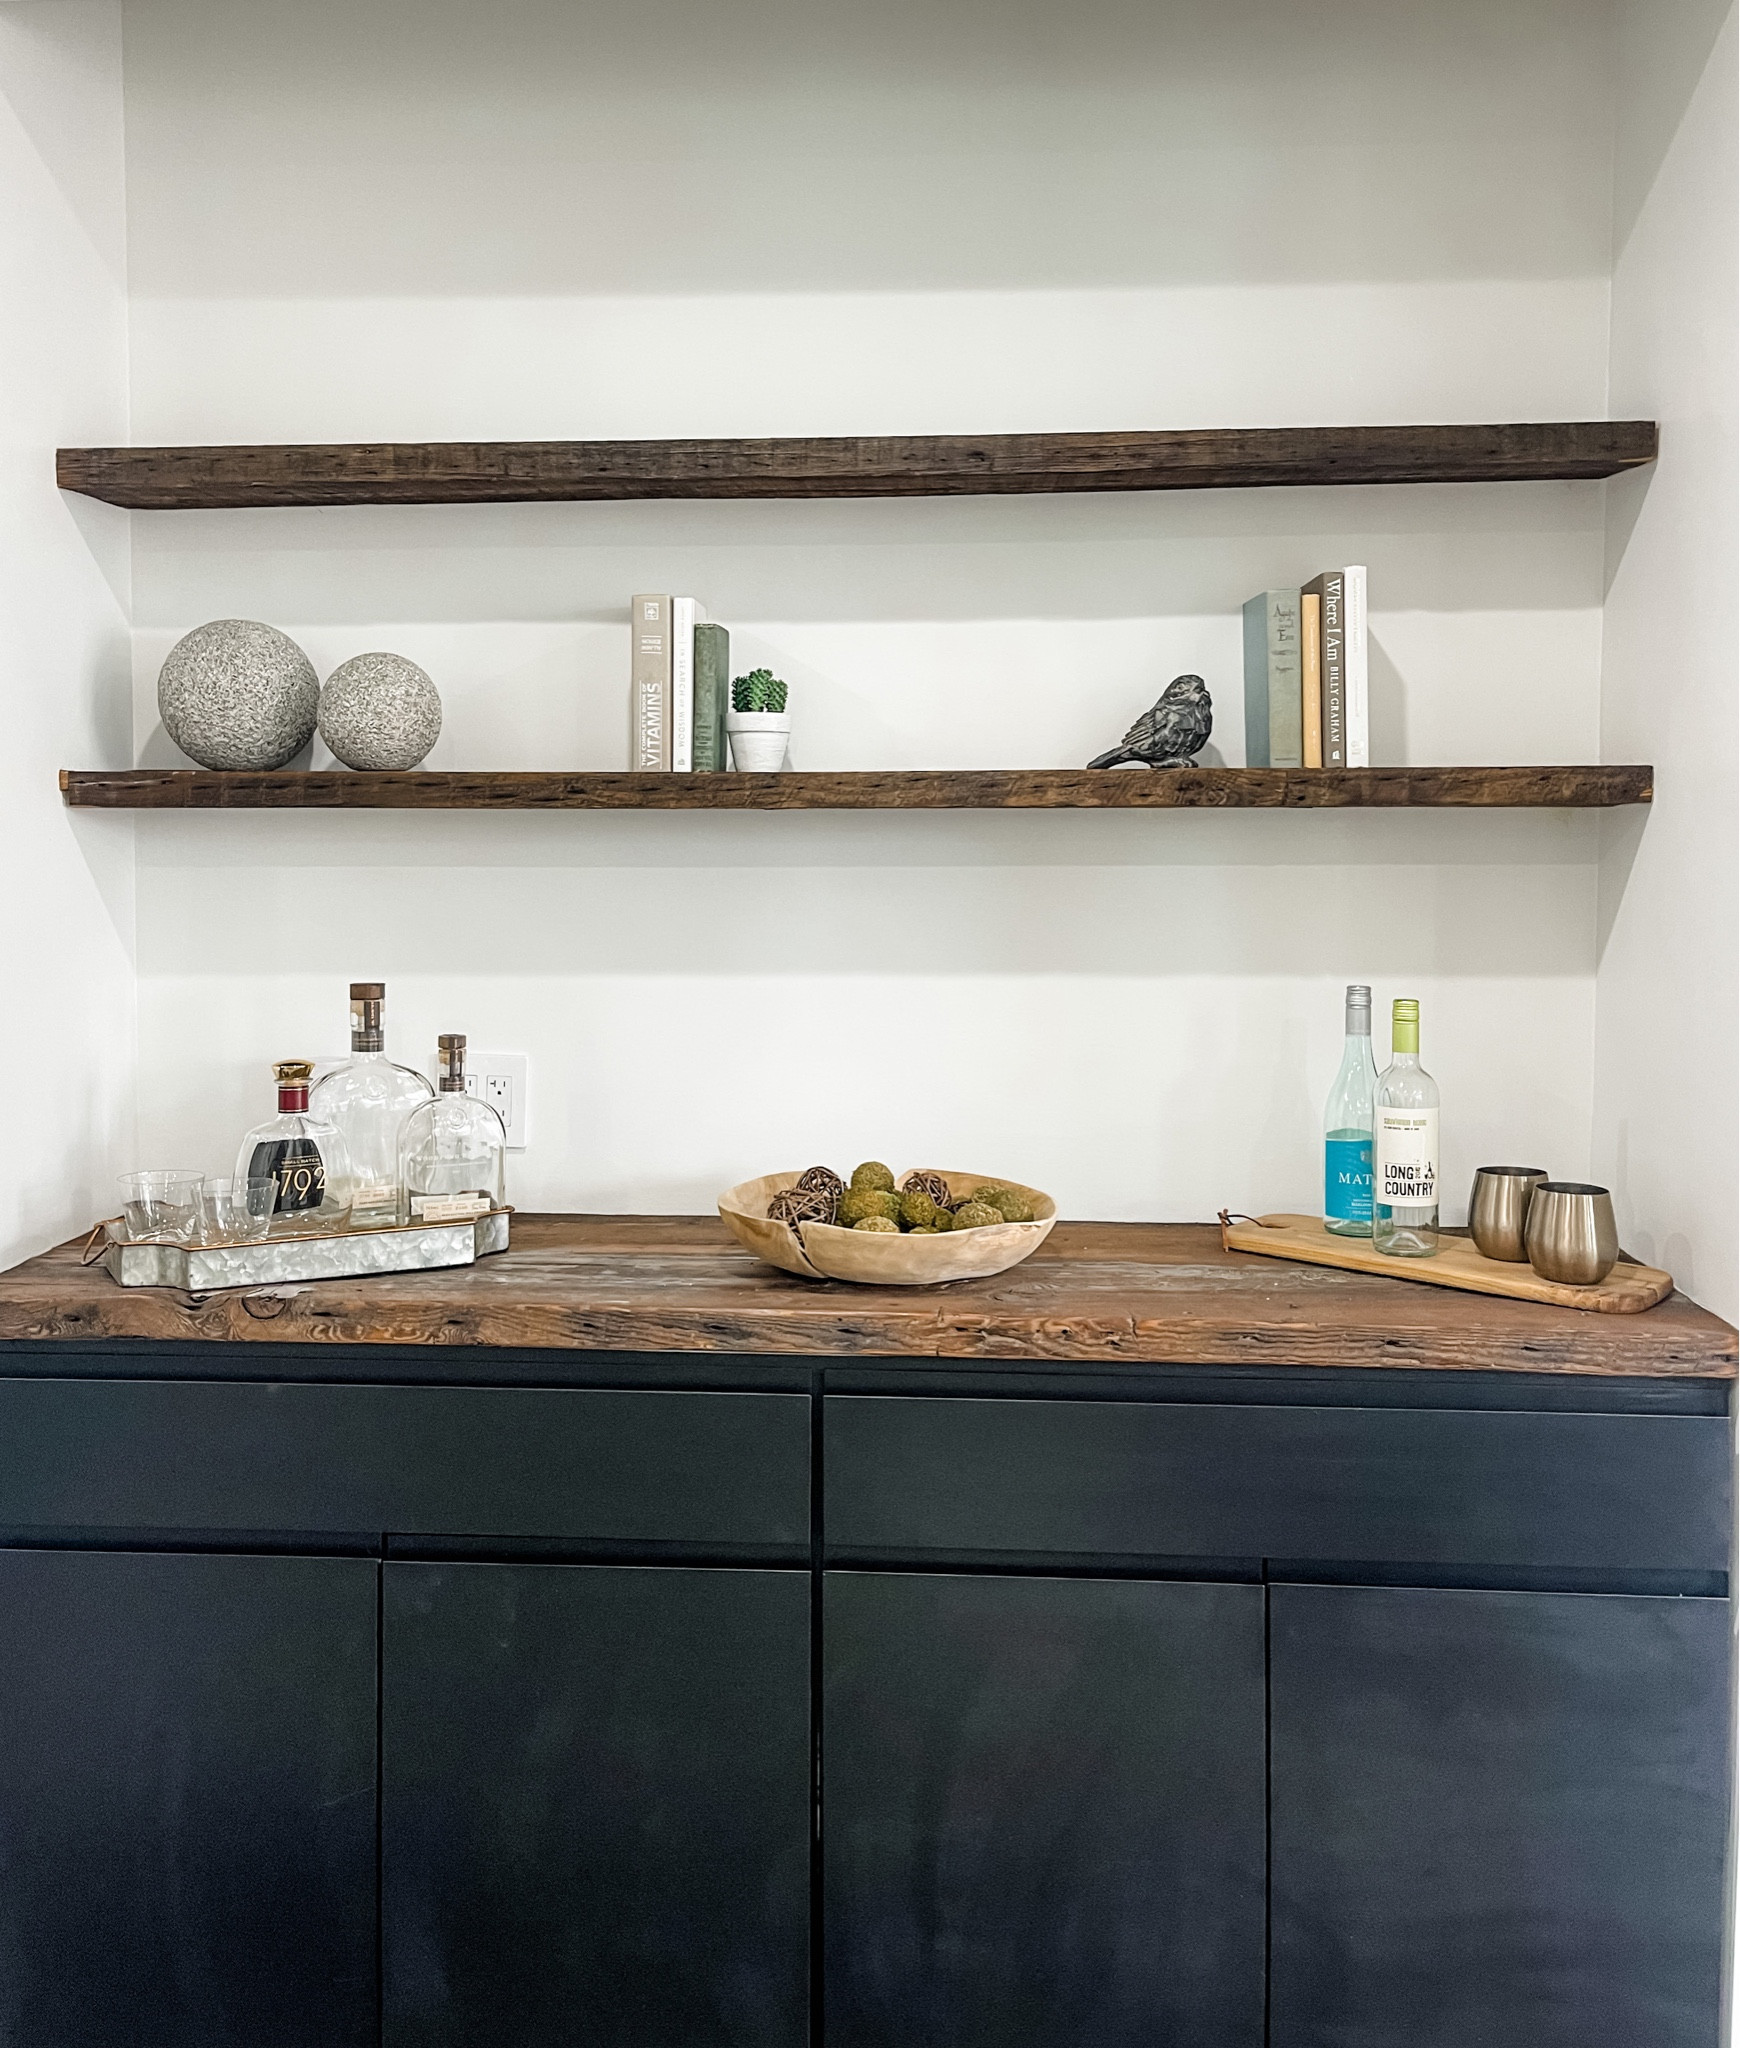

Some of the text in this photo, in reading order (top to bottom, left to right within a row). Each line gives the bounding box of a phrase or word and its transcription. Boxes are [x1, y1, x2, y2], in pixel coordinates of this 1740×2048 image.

[1326, 578, 1341, 625] Where
[1326, 635, 1341, 661] Am
[641, 683, 647, 692] OF
[1330, 666, 1340, 742] BILLY GRAHAM
[646, 682, 662, 767] VITAMINS
[271, 1166, 326, 1201] 1792
[1385, 1164, 1414, 1180] LONG
[1385, 1181, 1434, 1197] COUNTRY
